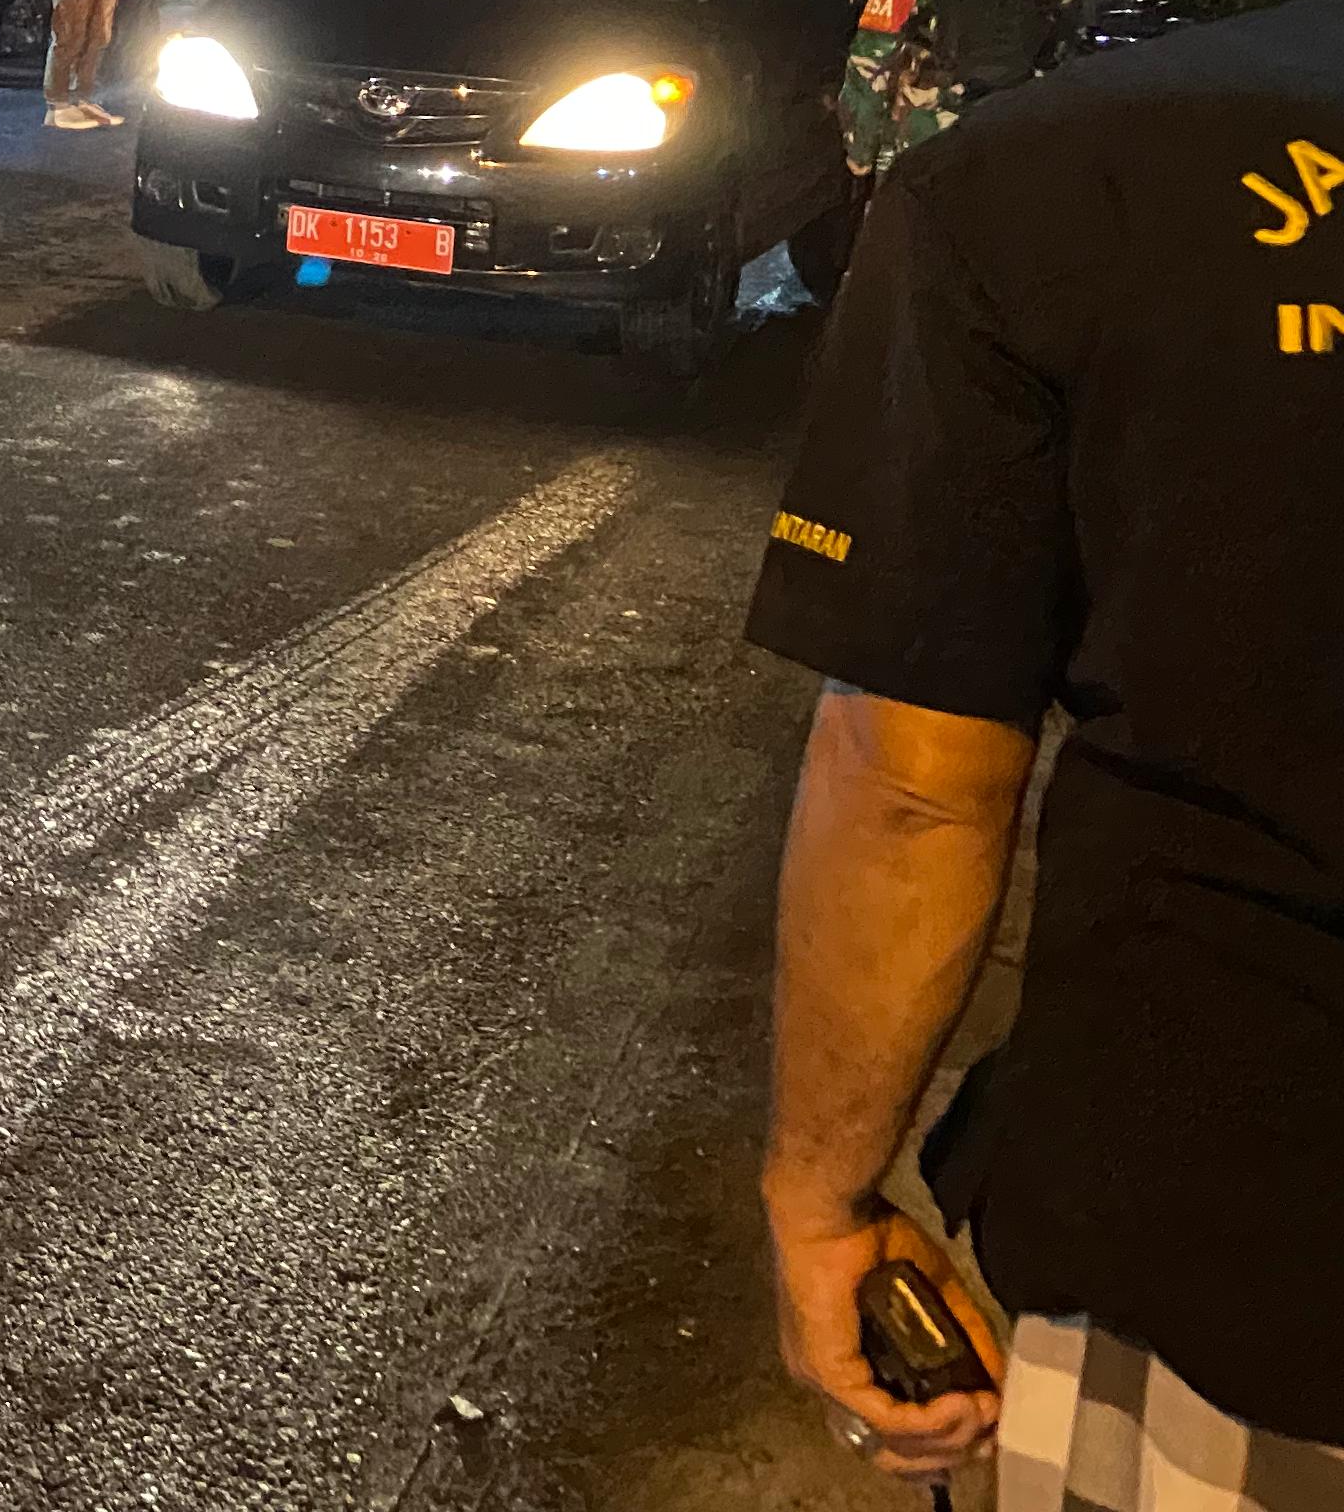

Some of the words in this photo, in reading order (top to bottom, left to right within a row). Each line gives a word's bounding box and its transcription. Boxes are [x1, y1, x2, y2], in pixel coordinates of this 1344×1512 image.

[292, 210, 321, 241] DK
[345, 217, 400, 249] 1153
[435, 230, 451, 256] B
